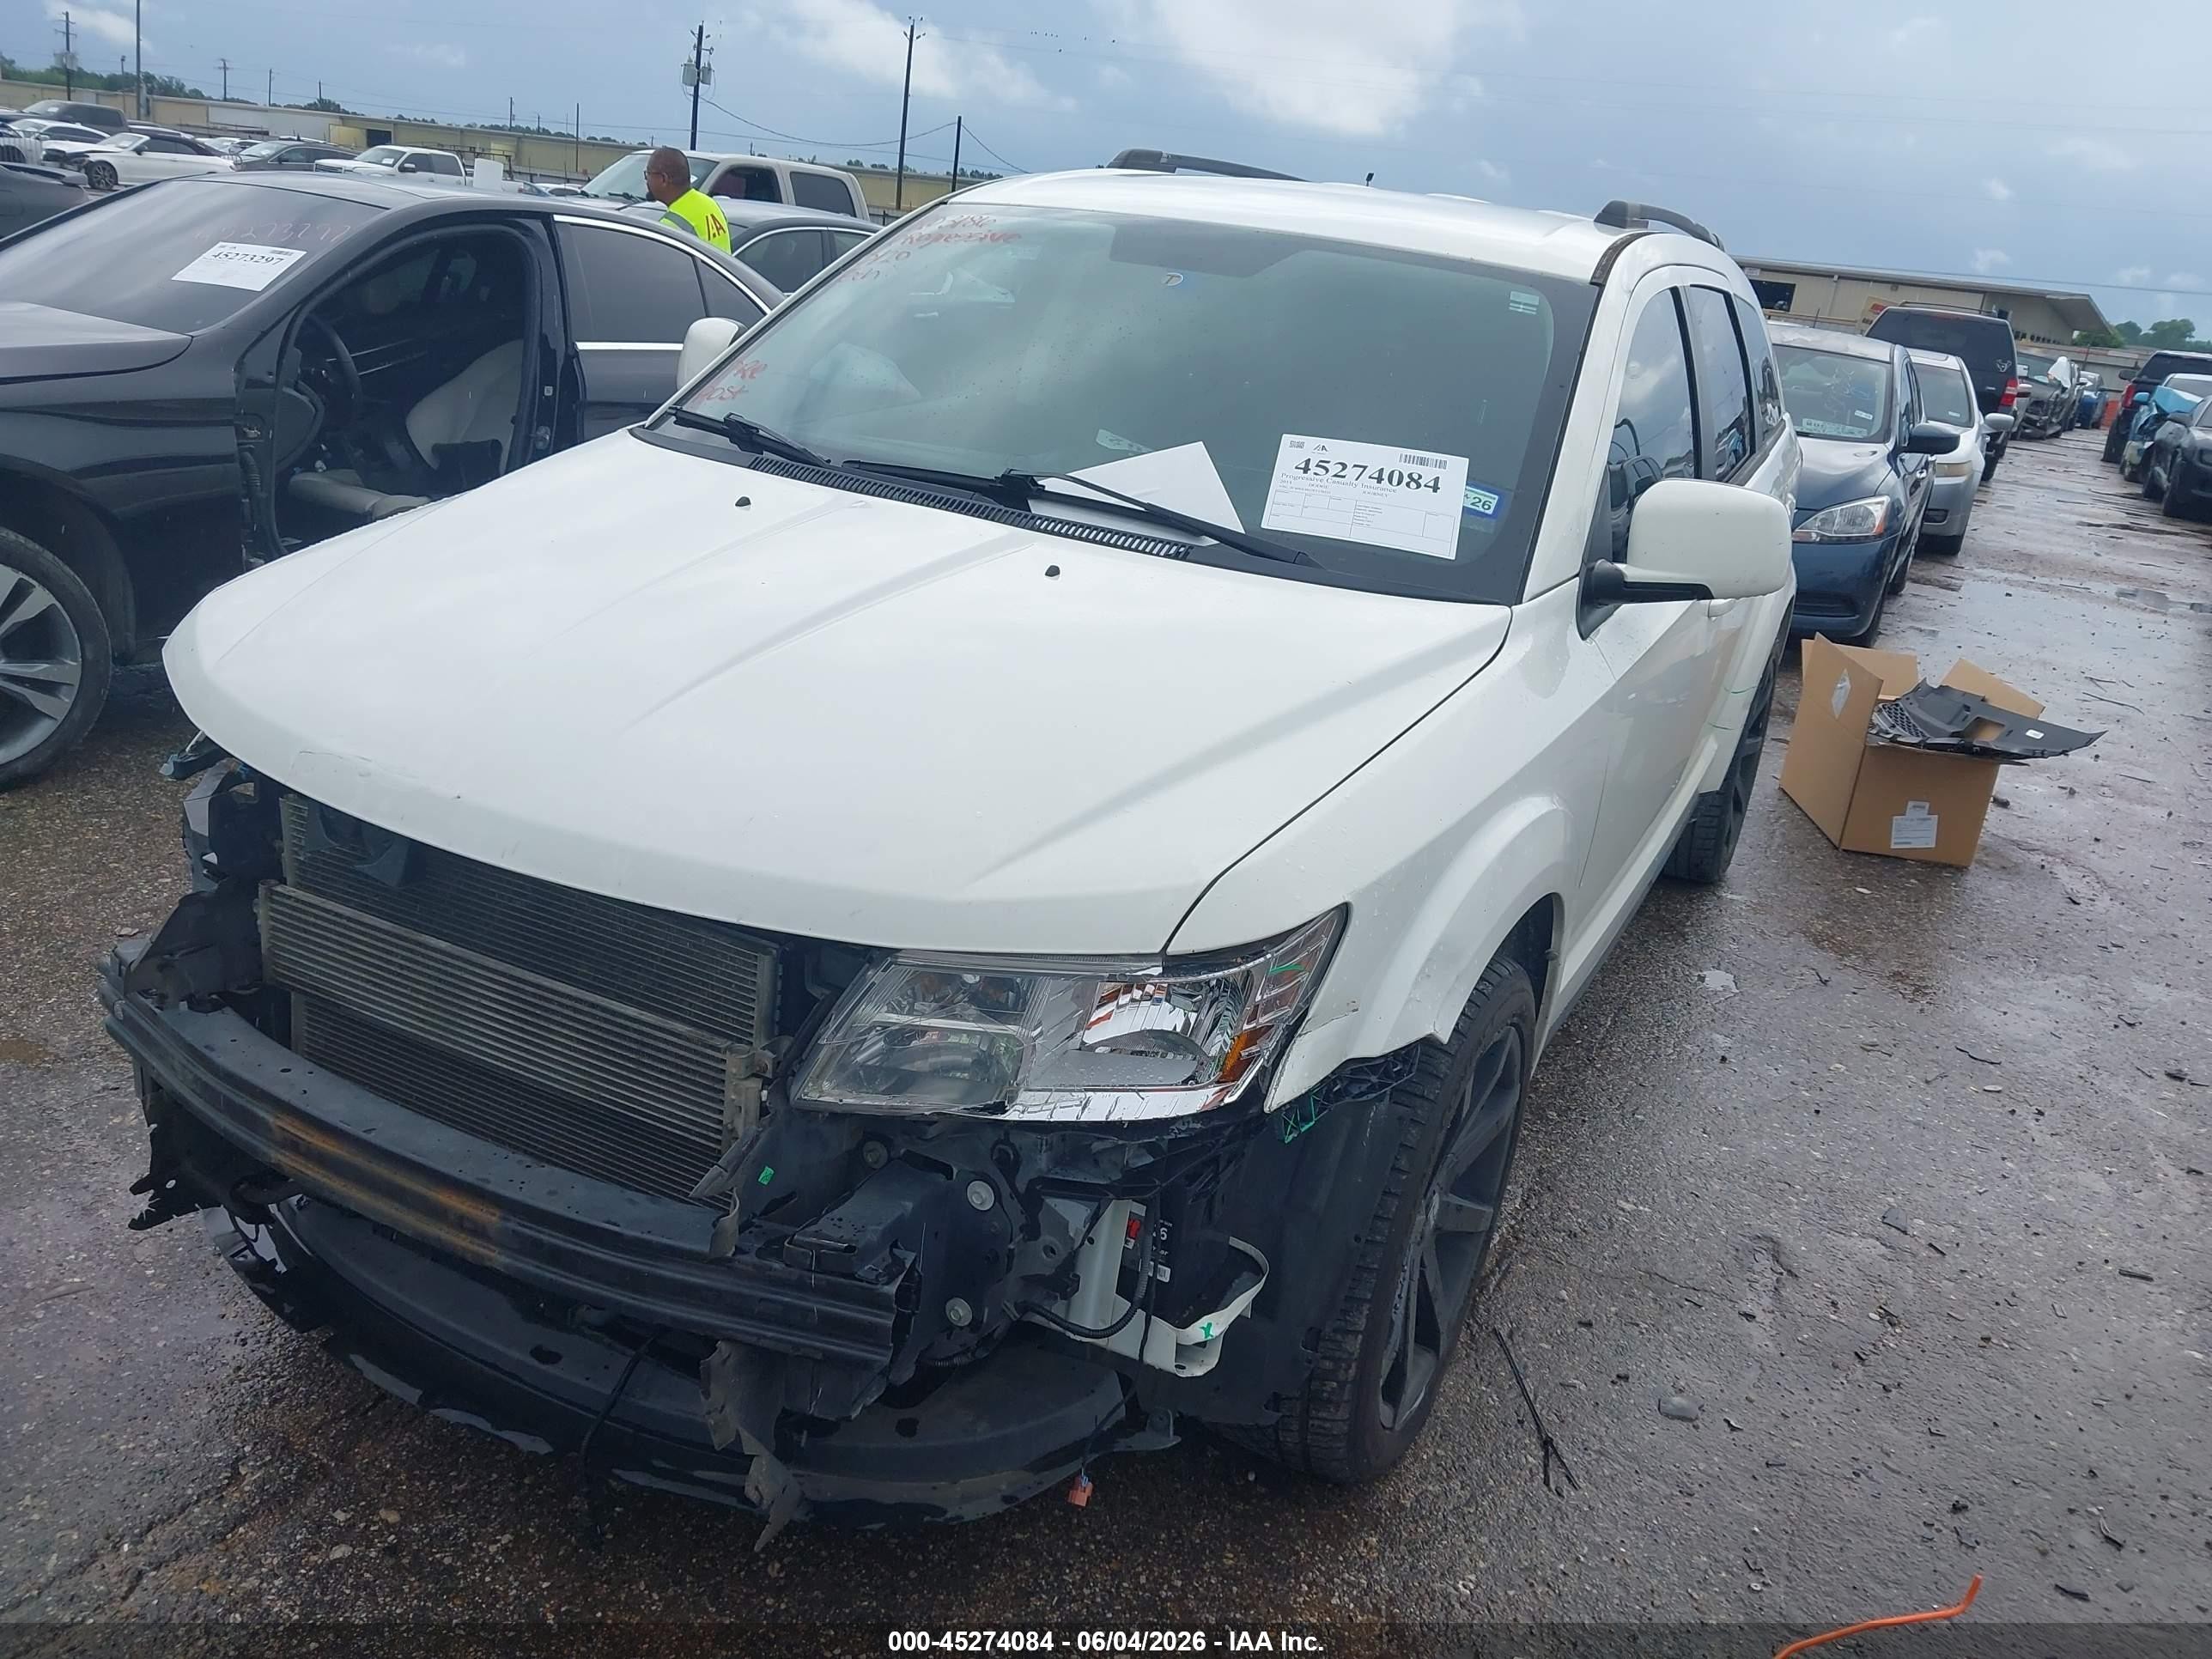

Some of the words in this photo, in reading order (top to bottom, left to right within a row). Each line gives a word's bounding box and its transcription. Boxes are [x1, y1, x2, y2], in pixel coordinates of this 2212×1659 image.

[211, 251, 285, 266] 45273297
[1281, 473, 1325, 483] Progressive
[1326, 477, 1358, 489] Casualty
[1361, 483, 1398, 494] Insurance
[1294, 458, 1441, 494] 45274084
[1469, 496, 1493, 511] 26
